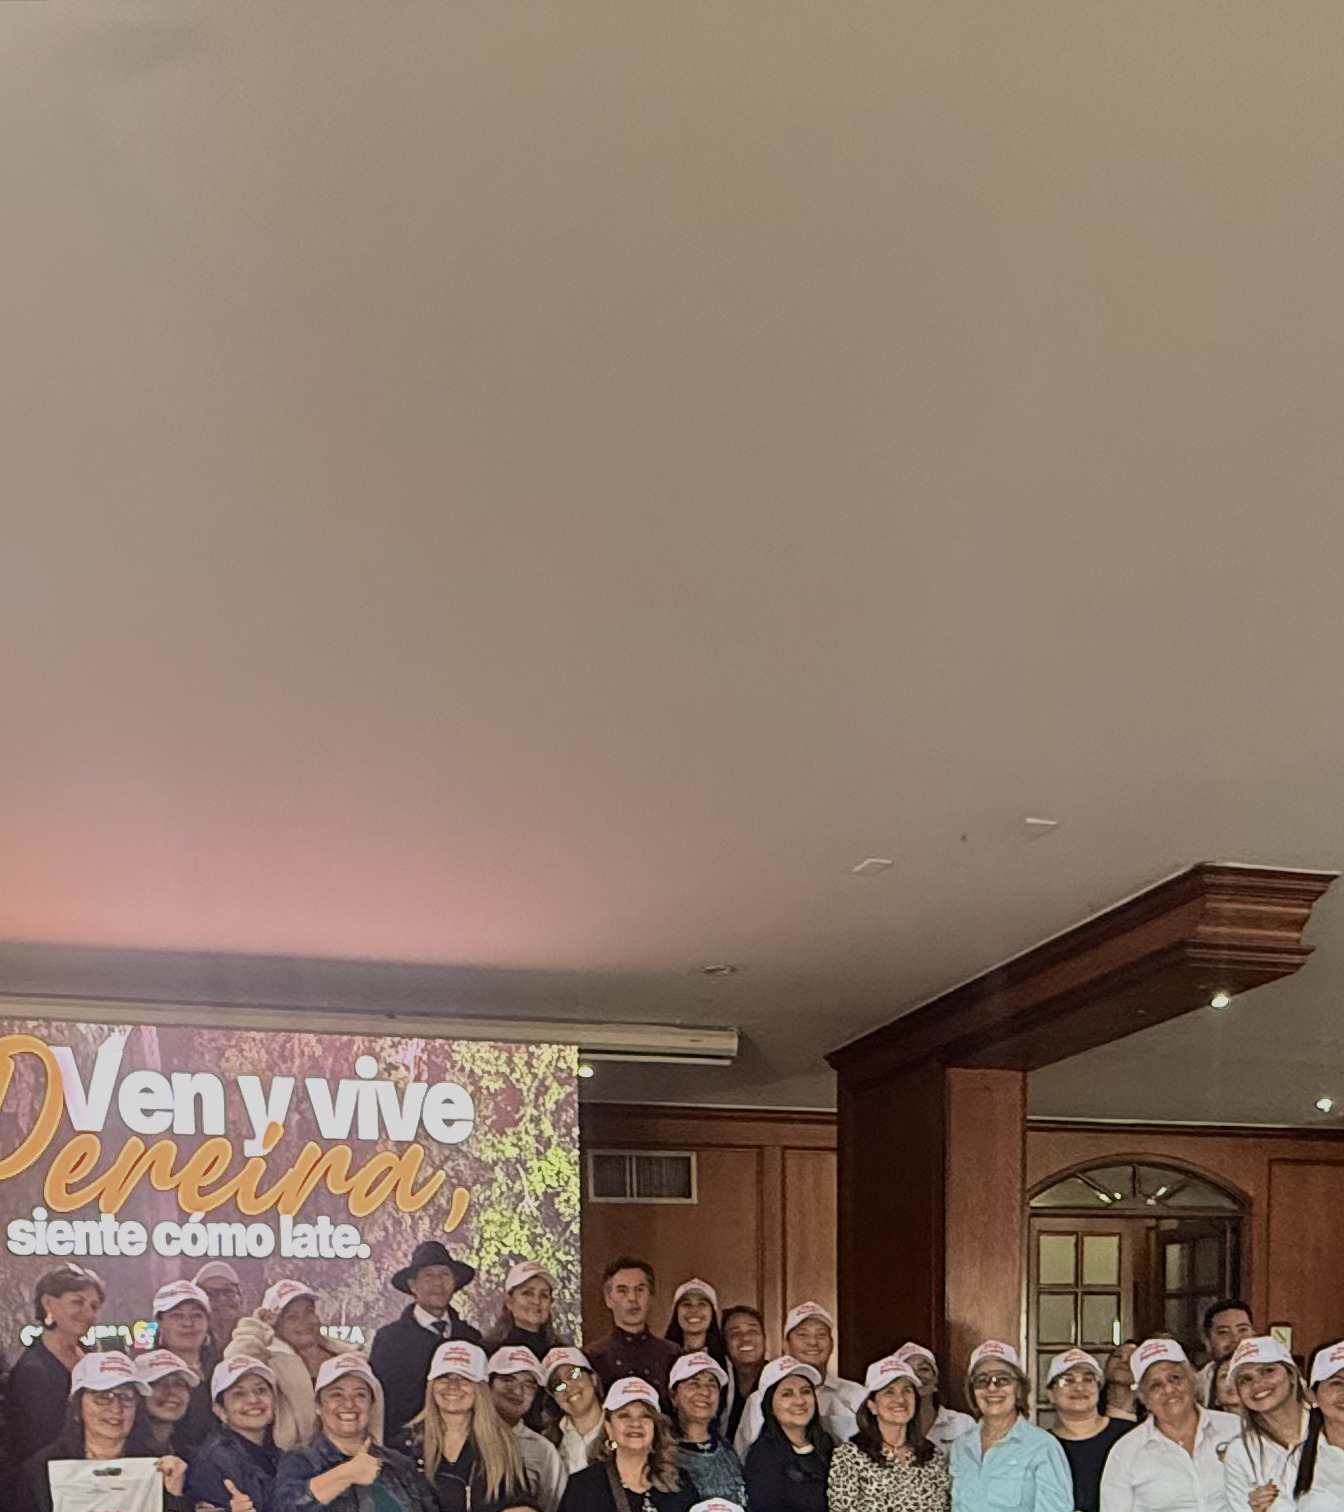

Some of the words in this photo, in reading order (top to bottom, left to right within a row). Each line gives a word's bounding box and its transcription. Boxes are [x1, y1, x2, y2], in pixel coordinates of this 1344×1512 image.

[51, 1030, 226, 1136] Ven
[238, 1075, 296, 1157] y
[305, 1055, 475, 1144] vive
[6, 1207, 148, 1258] siente
[152, 1210, 275, 1259] cómo
[280, 1215, 372, 1260] late.
